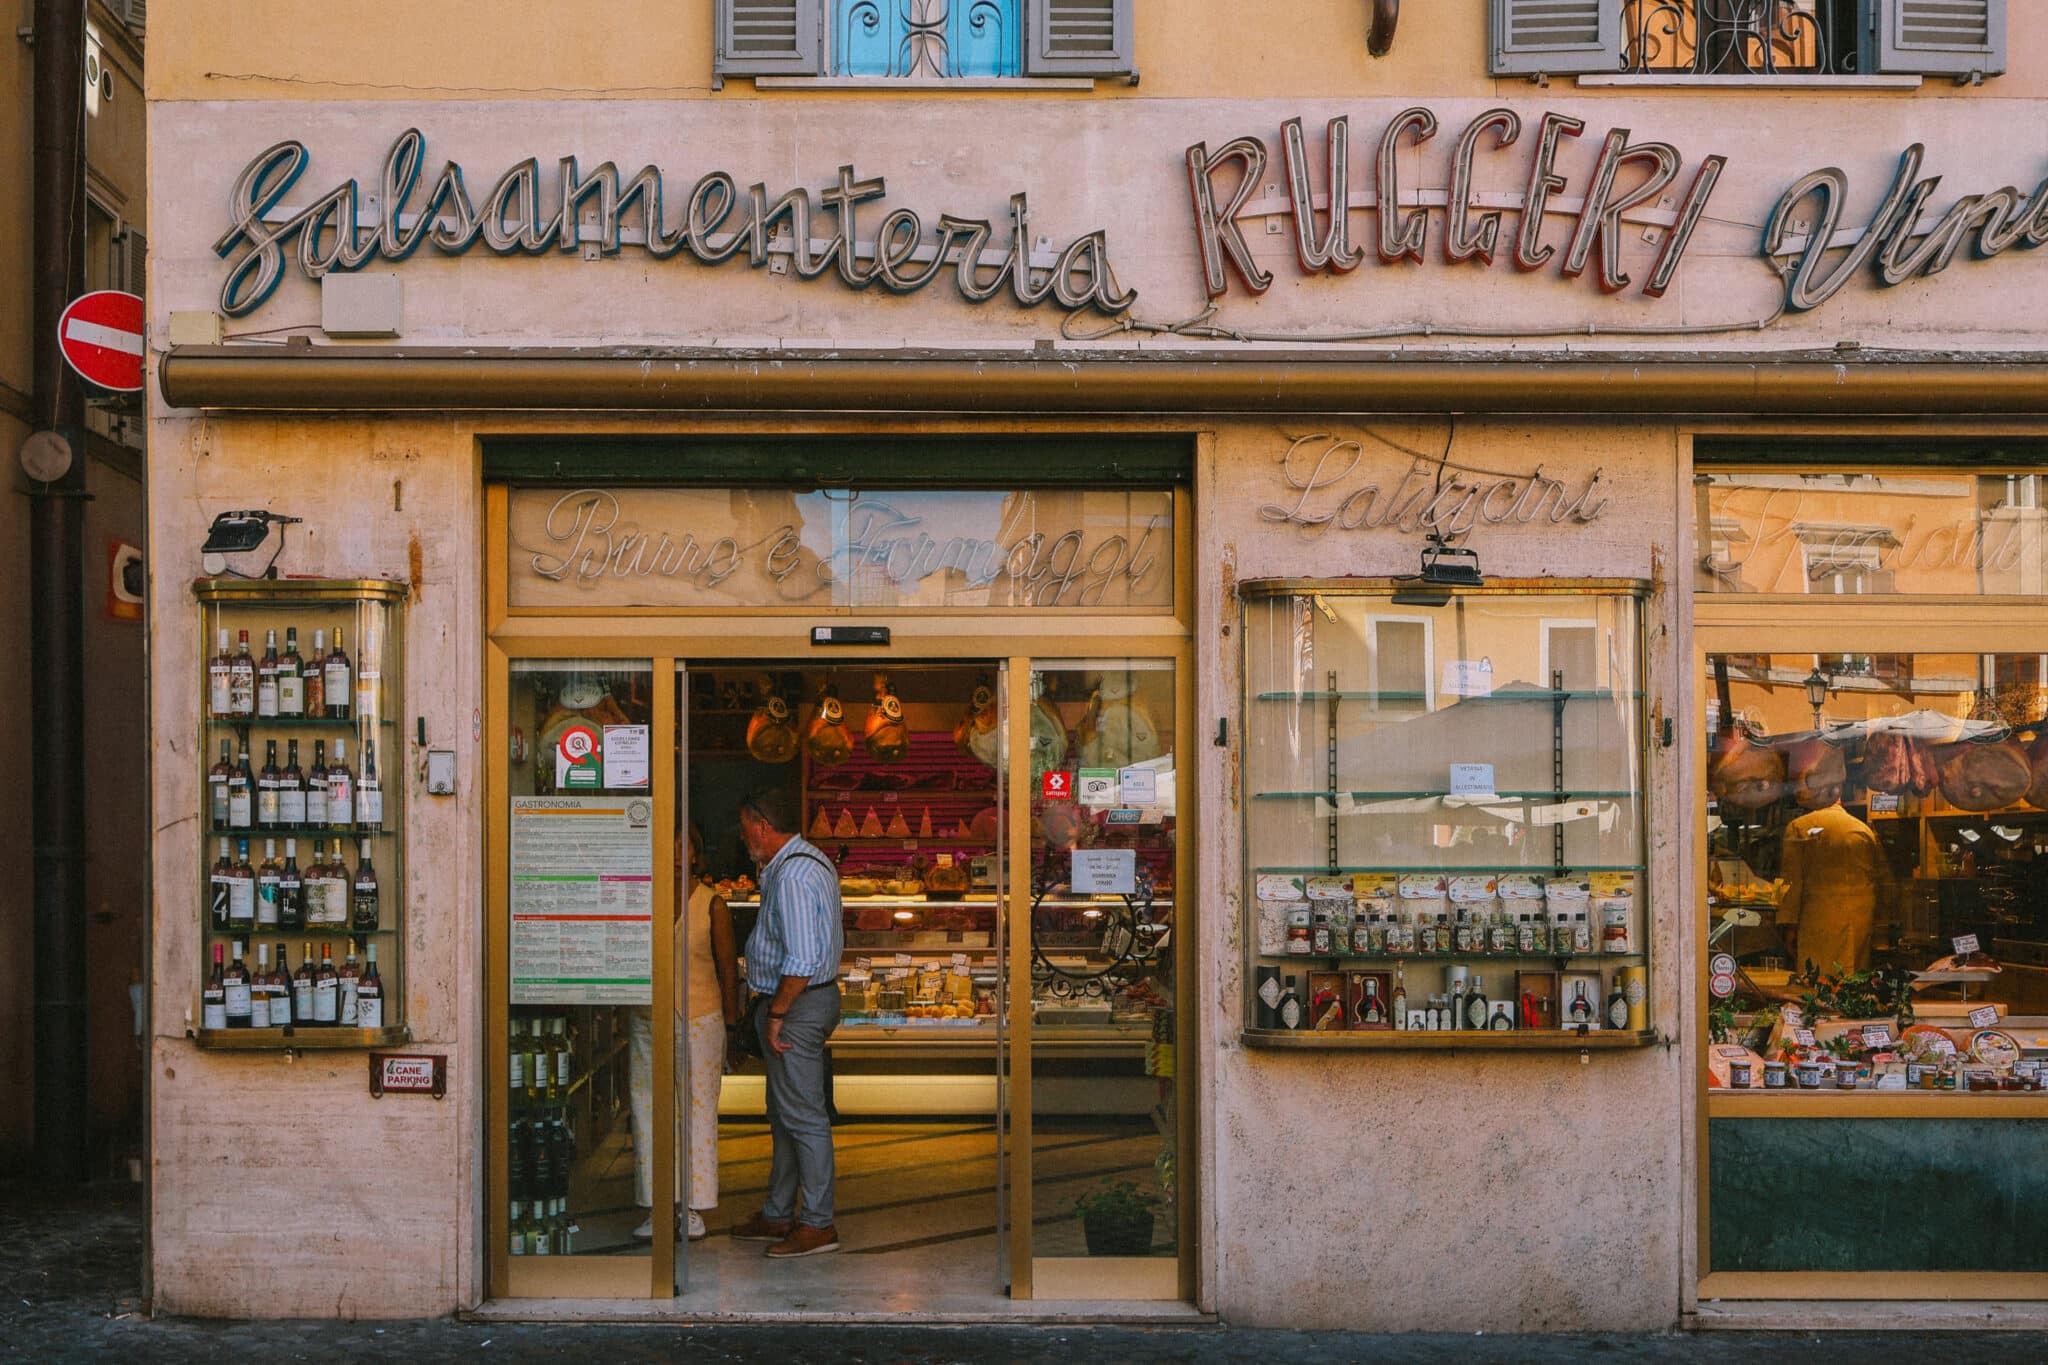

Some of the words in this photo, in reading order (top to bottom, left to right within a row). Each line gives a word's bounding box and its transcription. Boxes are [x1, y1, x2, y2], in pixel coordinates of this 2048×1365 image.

[1185, 106, 1728, 298] RUGGERI
[531, 488, 744, 587] Burro
[514, 800, 582, 809] GASTRONOMIA
[395, 1066, 422, 1075] CANE
[387, 1075, 430, 1085] PARKING
